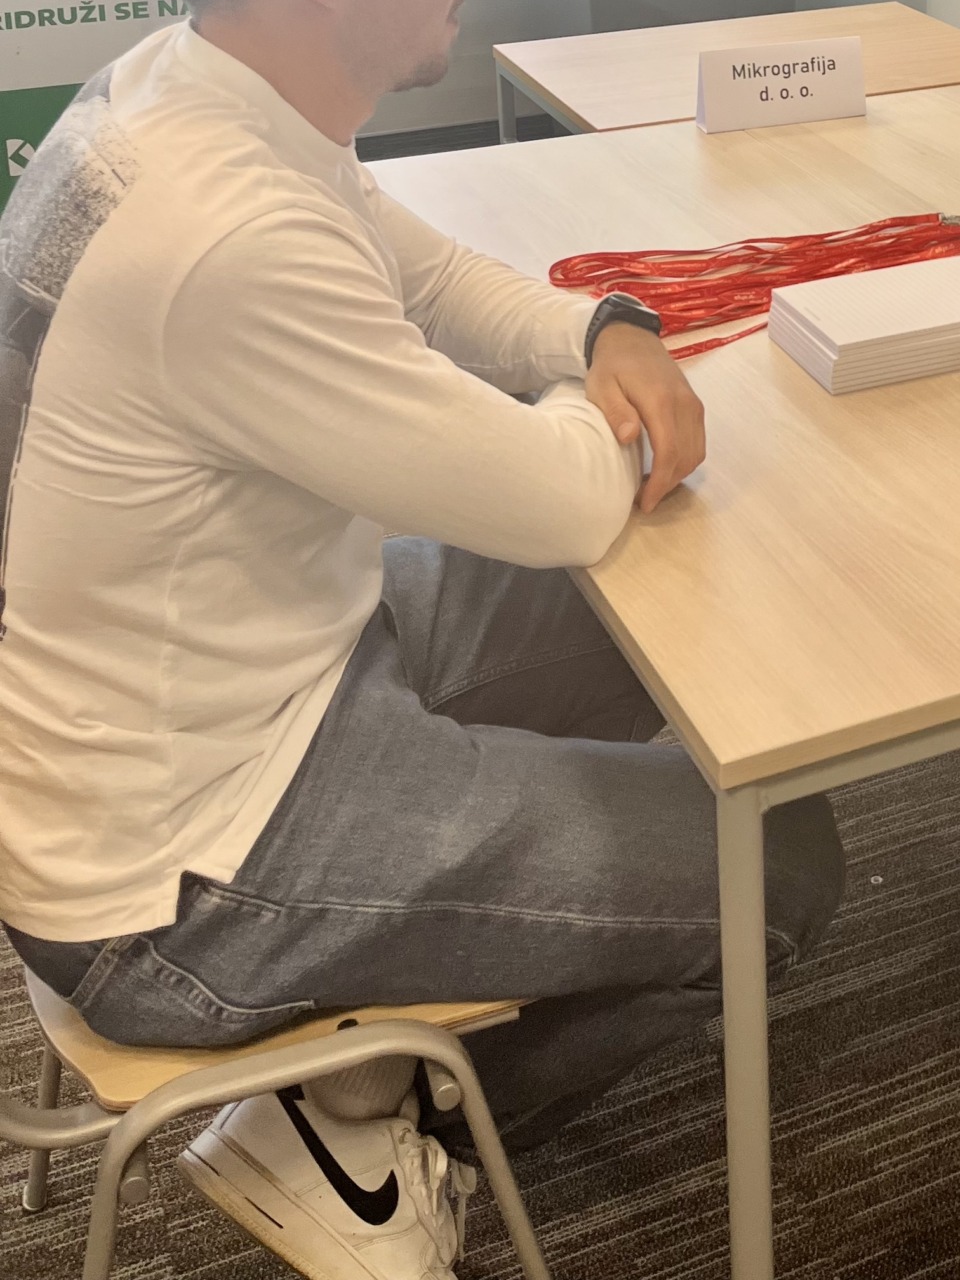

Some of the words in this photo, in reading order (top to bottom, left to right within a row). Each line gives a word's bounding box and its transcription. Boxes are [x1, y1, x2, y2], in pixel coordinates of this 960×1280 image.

[0, 0, 106, 31] IDRUŽI
[114, 1, 150, 21] SE
[731, 56, 837, 81] Mikrografija
[759, 86, 774, 102] d.
[780, 88, 794, 100] o.
[799, 86, 814, 98] o.
